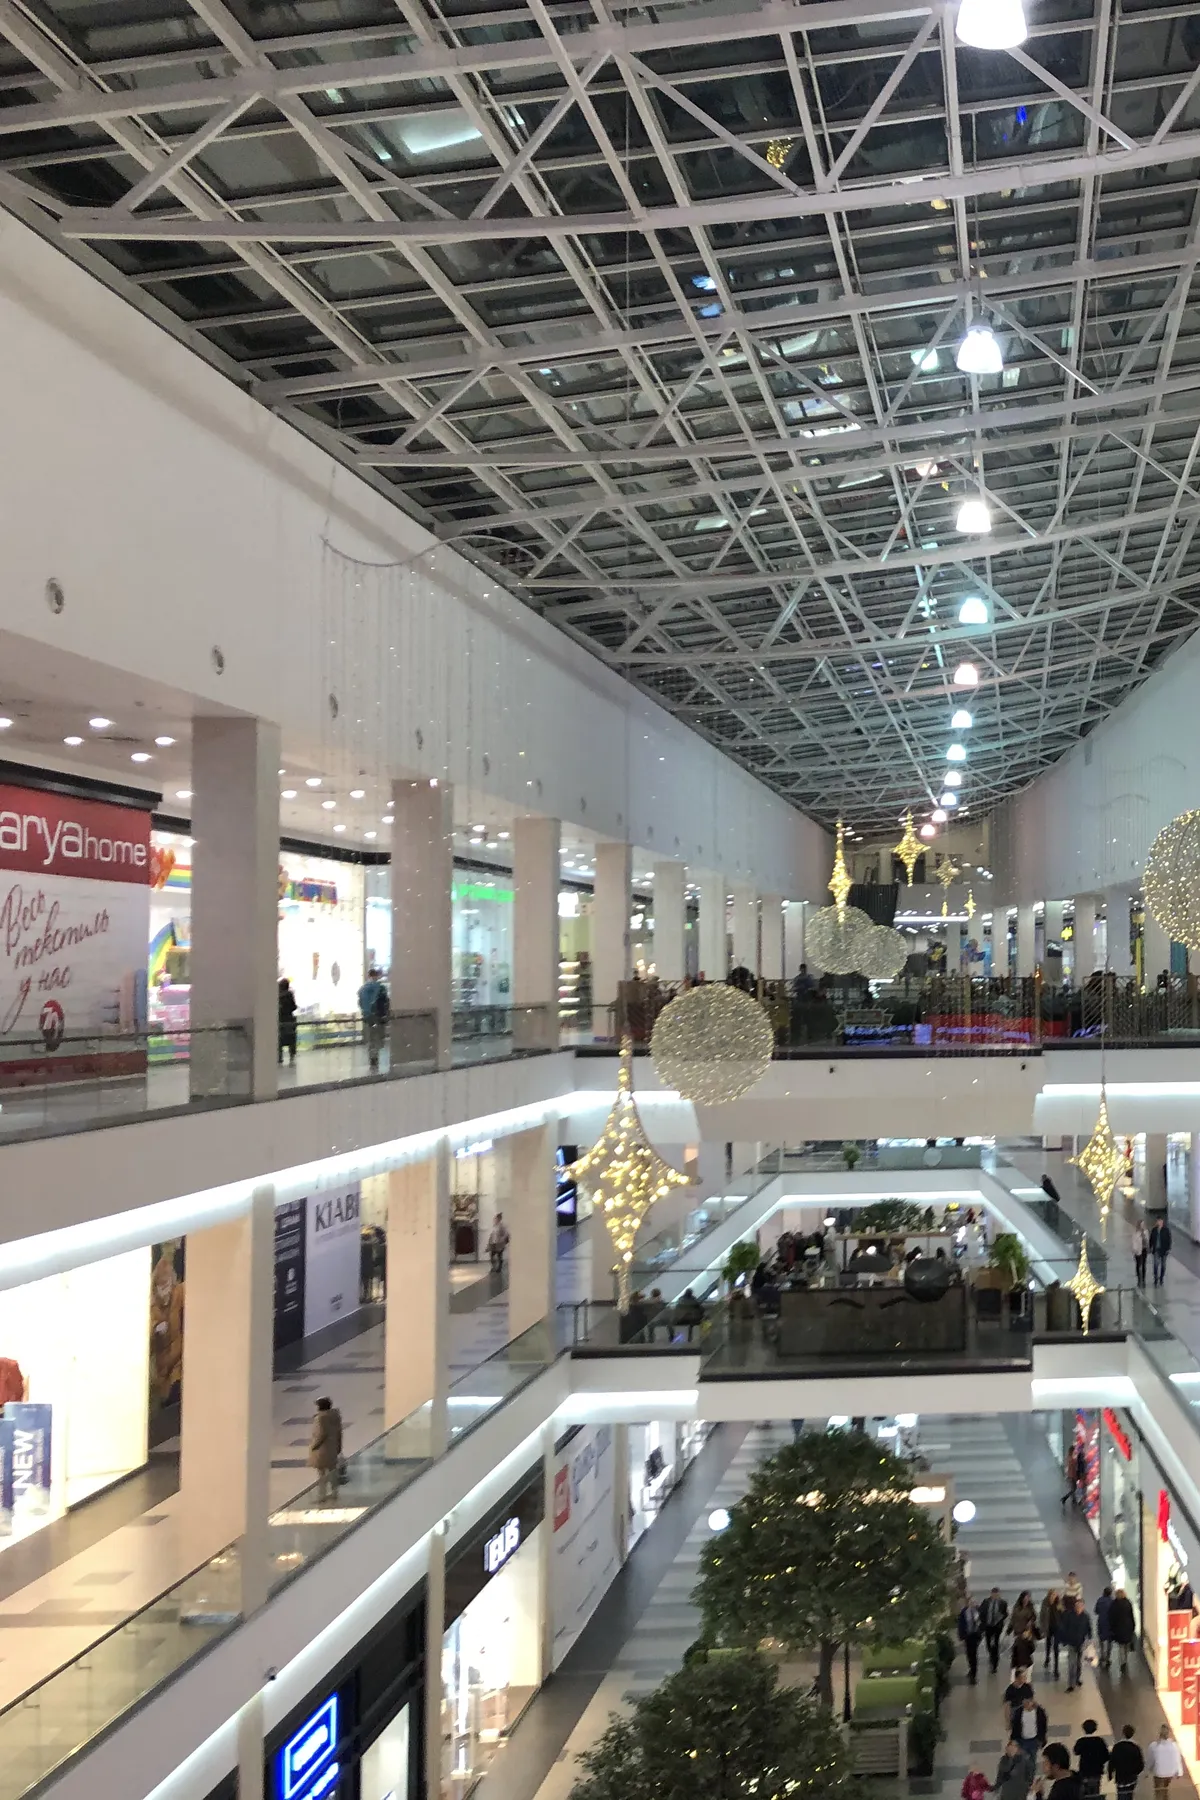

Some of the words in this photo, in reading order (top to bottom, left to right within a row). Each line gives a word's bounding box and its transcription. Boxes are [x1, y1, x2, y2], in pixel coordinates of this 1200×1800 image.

[0, 884, 45, 956] Весь
[14, 901, 110, 969] текстиль
[38, 967, 71, 991] нас
[12, 1429, 34, 1489] NEW
